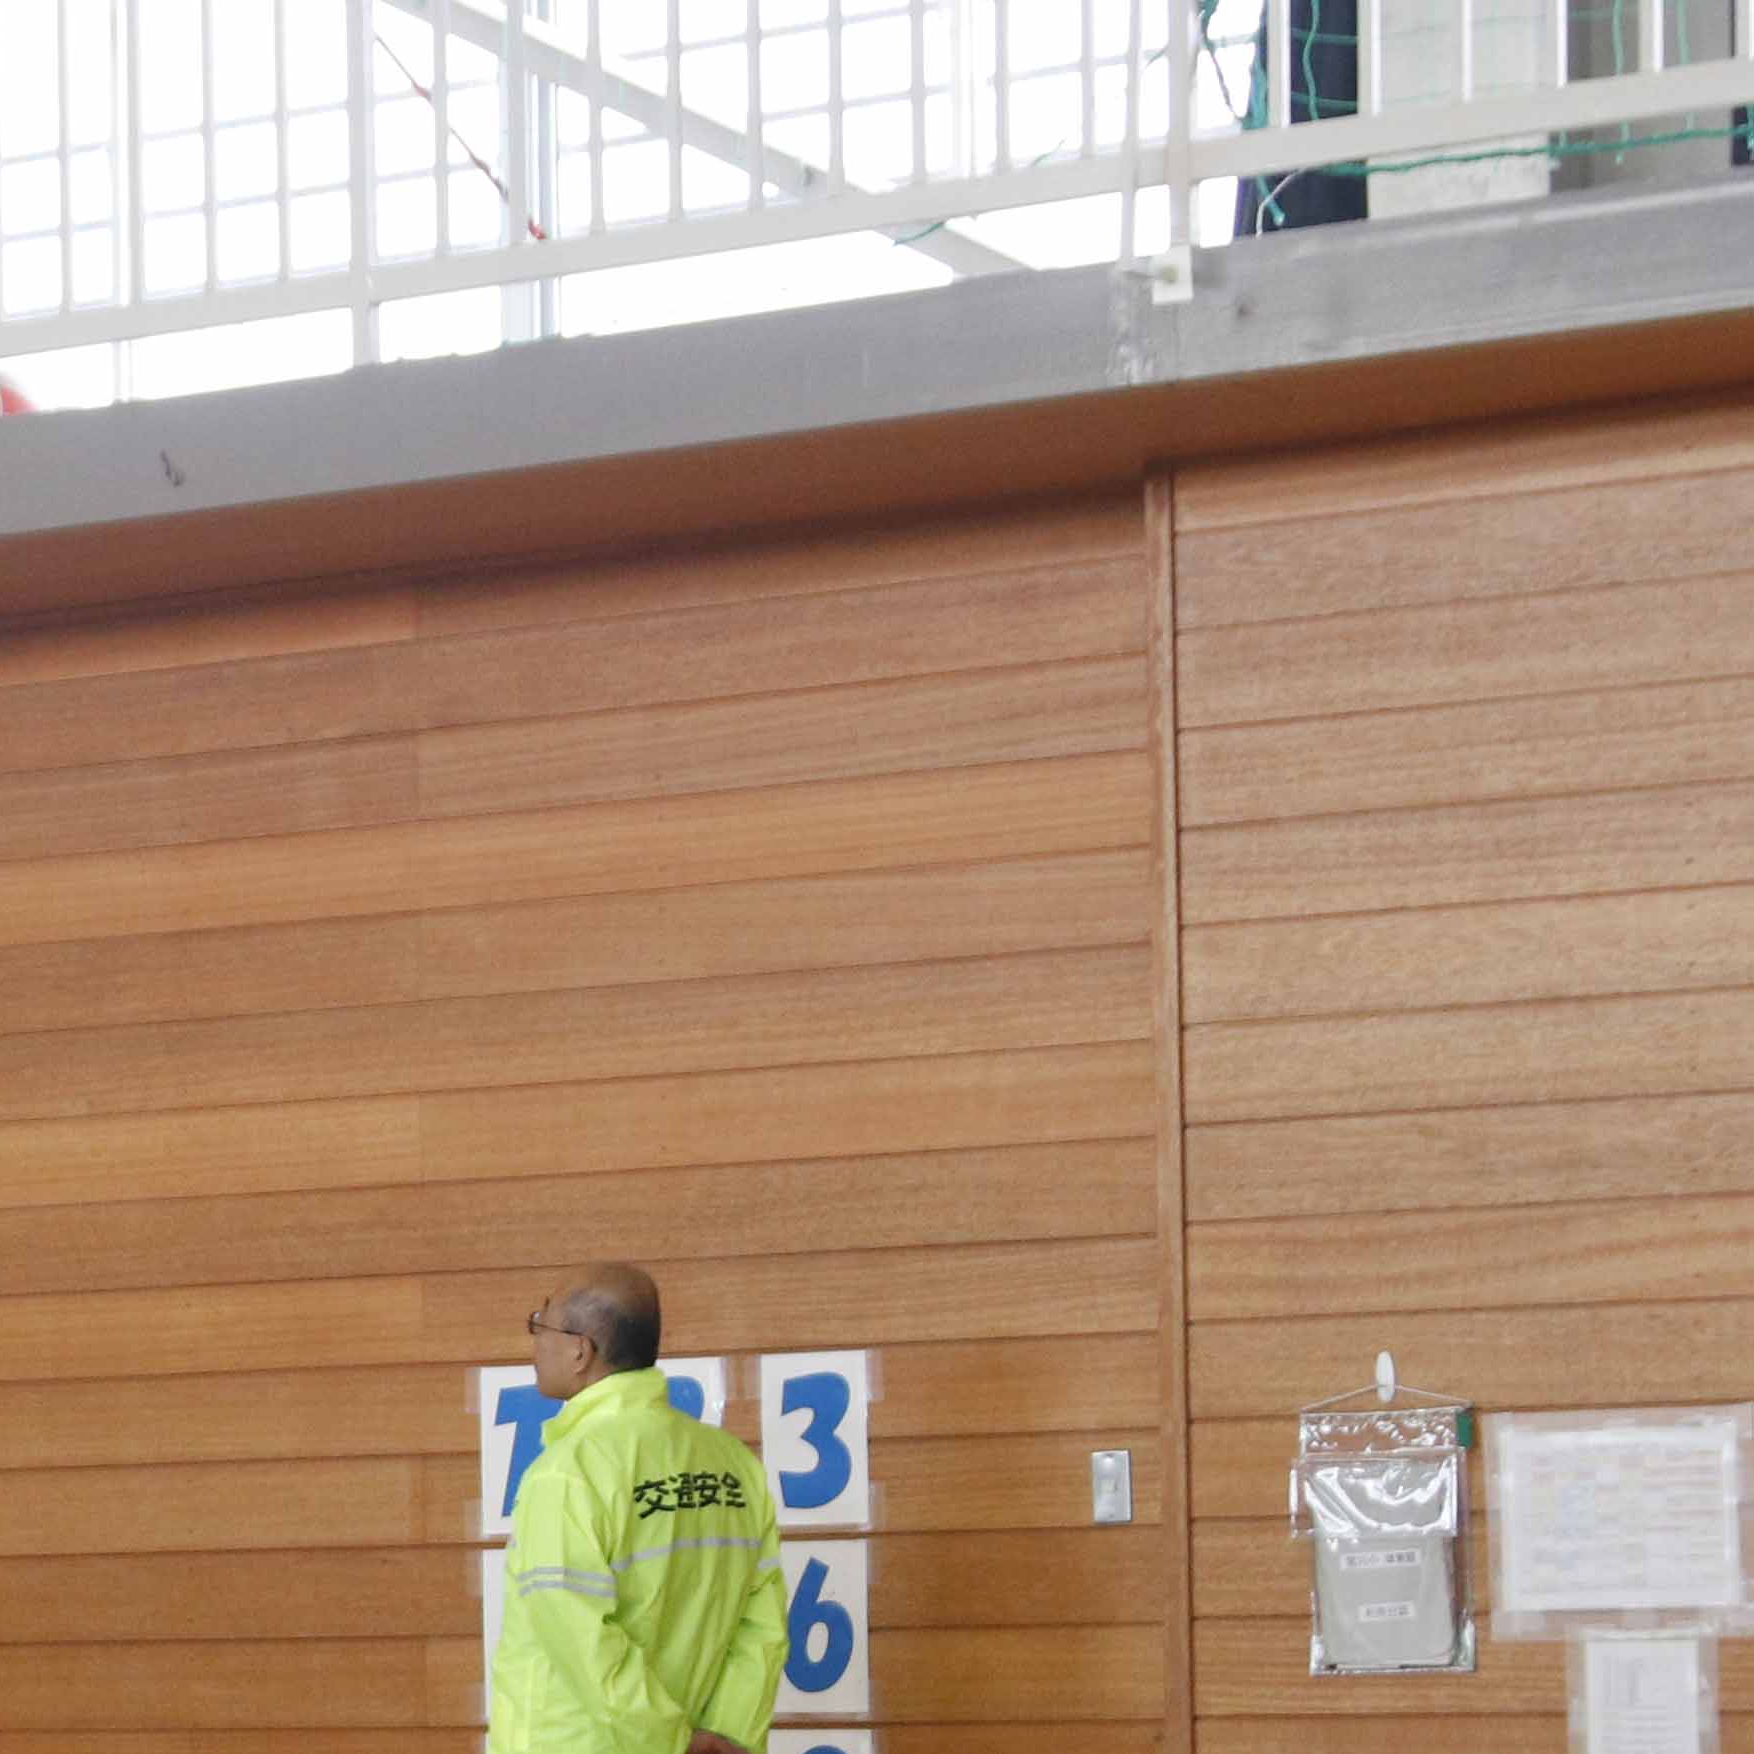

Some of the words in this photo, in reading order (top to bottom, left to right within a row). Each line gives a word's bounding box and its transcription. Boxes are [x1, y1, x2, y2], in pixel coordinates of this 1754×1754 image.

[633, 1471, 746, 1519] 交通安全
[779, 1372, 852, 1509] 3
[784, 1556, 854, 1693] 6
